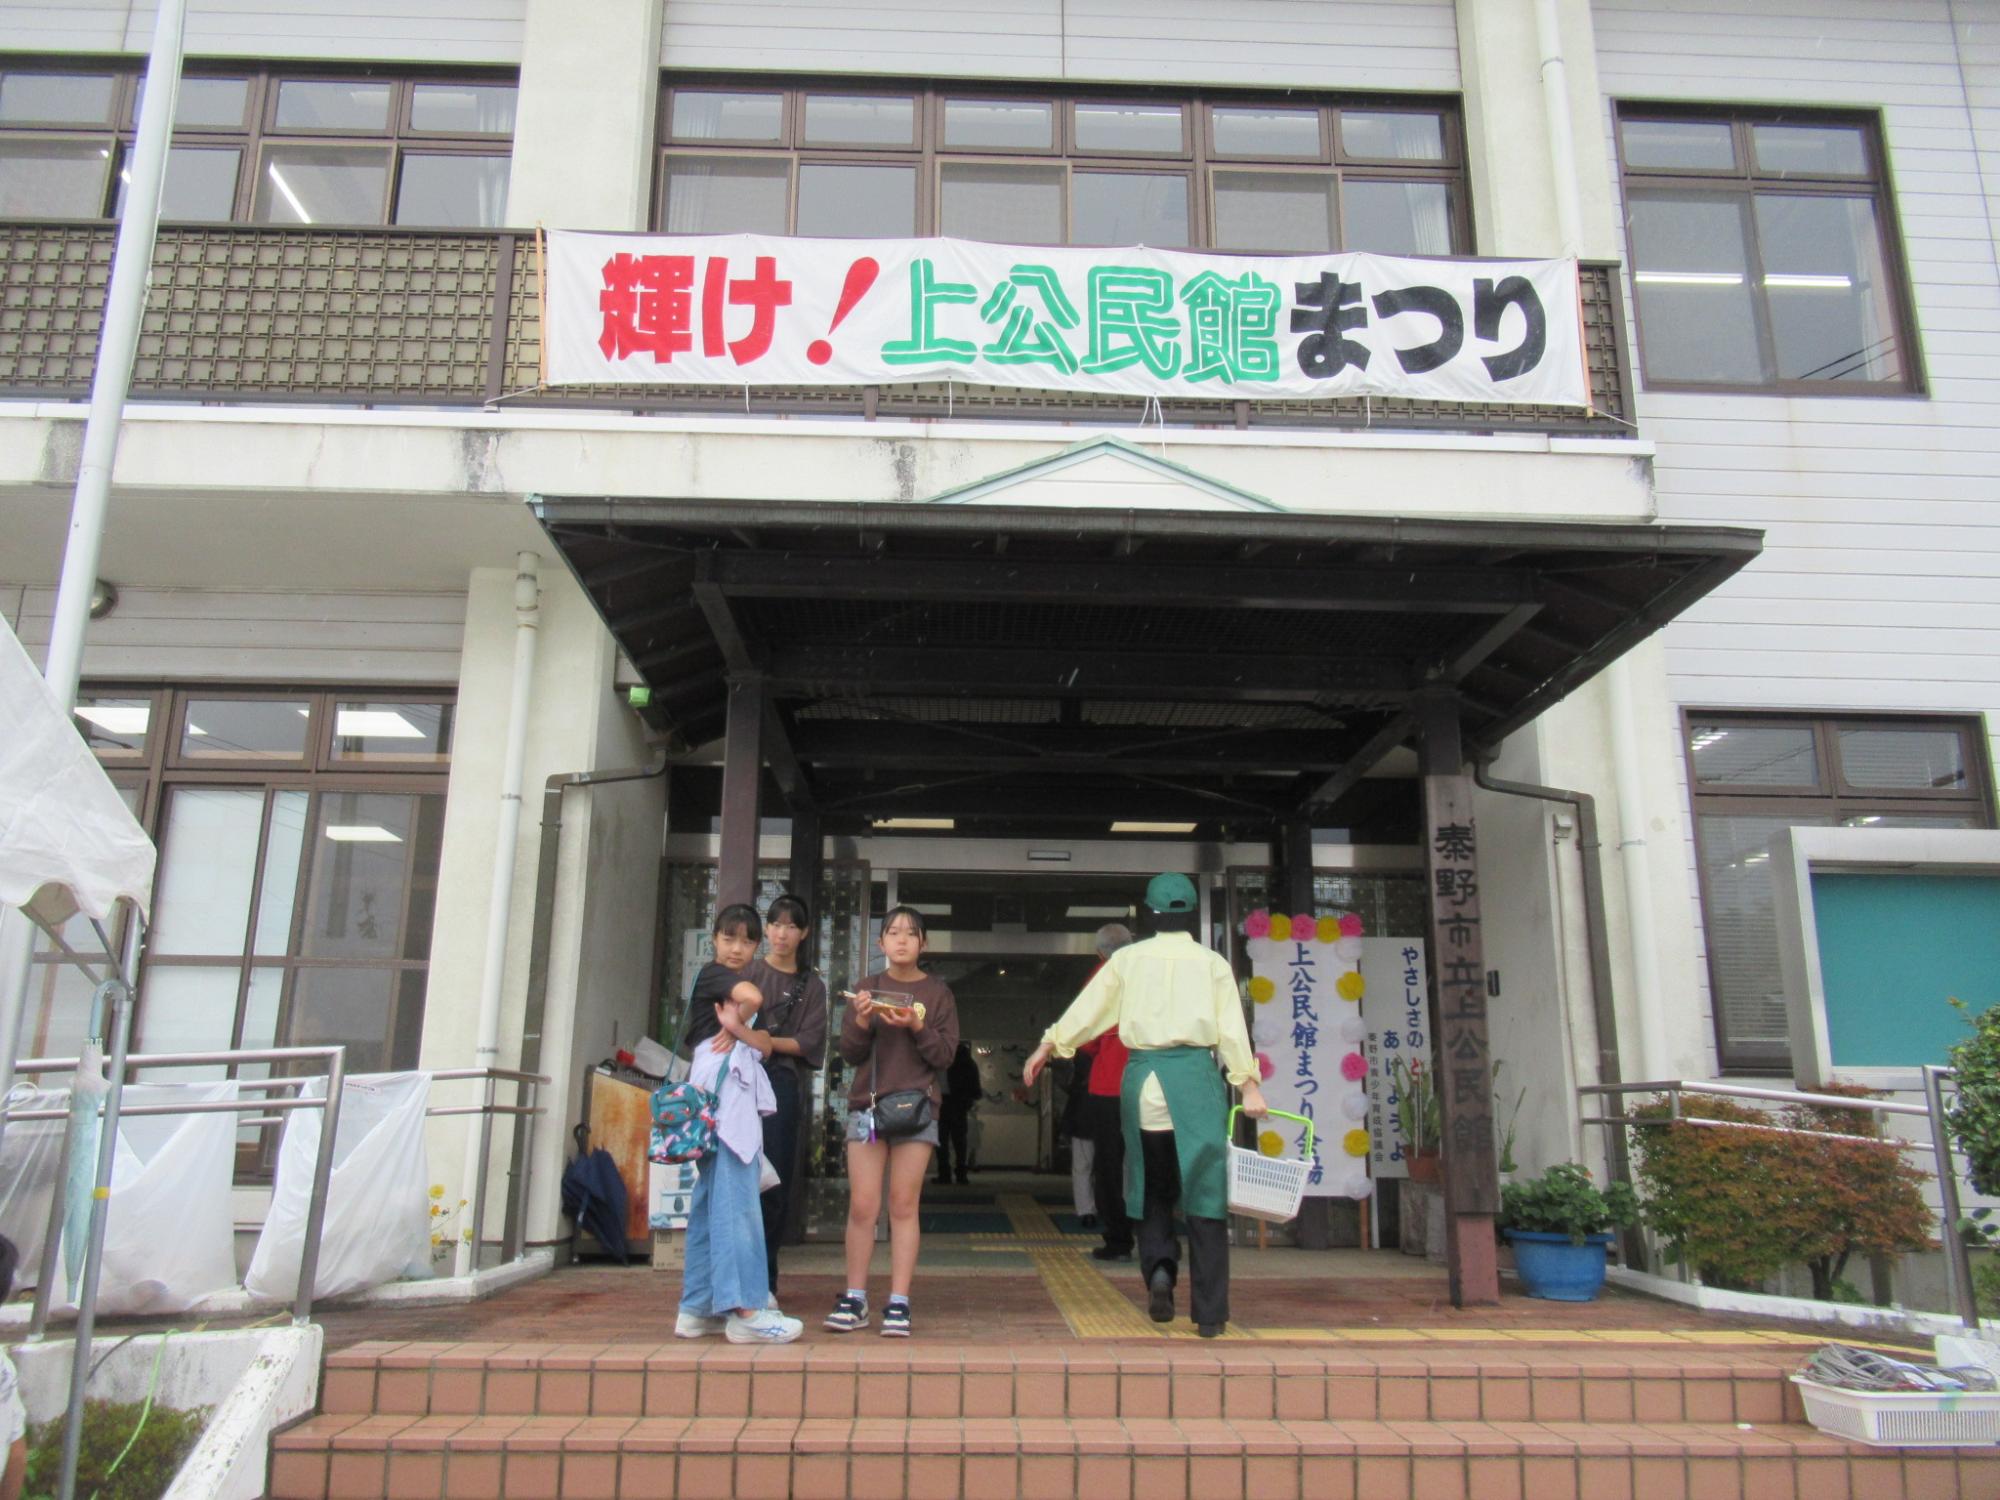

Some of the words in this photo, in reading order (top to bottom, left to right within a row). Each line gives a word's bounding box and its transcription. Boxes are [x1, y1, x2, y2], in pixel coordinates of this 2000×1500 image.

[1434, 823, 1493, 1153] 秦野市立上公民館
